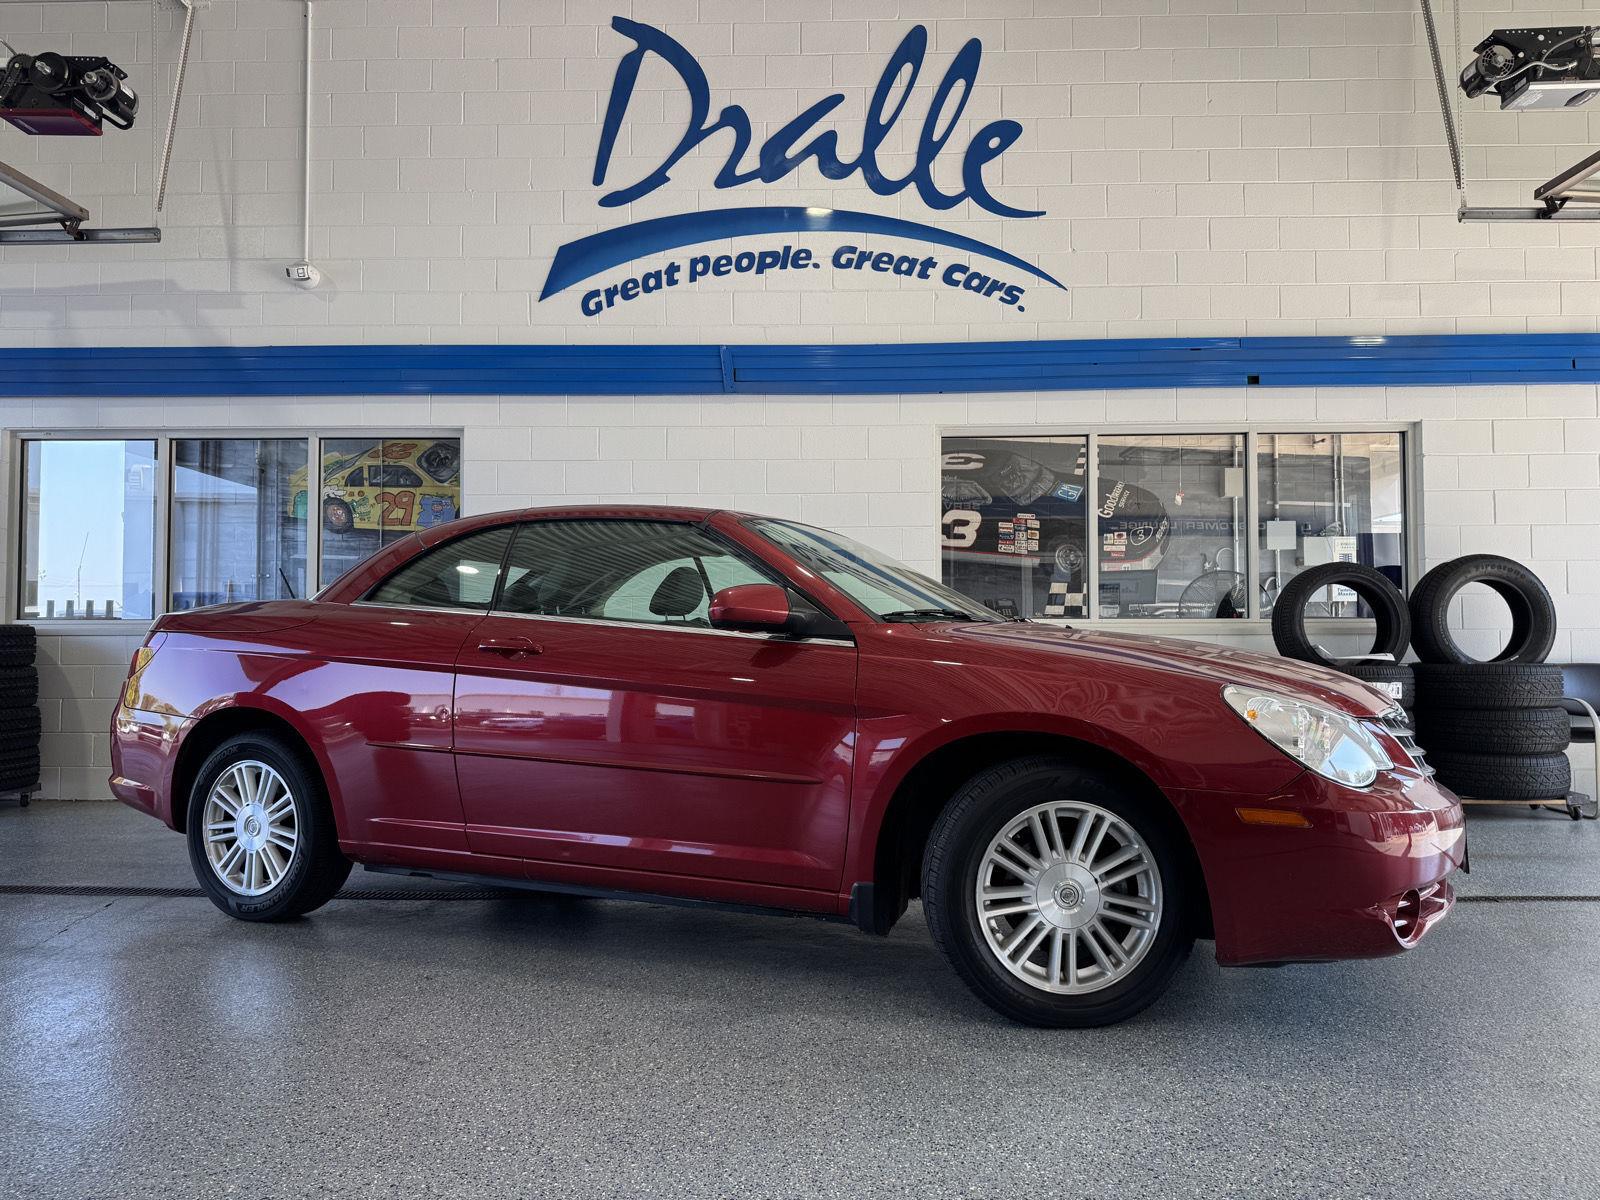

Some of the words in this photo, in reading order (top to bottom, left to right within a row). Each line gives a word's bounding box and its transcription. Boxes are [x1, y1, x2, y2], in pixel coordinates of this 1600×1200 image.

[592, 15, 1047, 218] Dralle
[581, 263, 681, 317] Great
[688, 245, 821, 284] people.
[831, 245, 937, 281] Great
[942, 263, 1026, 313] Cars.
[374, 490, 416, 527] 29
[941, 509, 982, 548] 3
[1137, 529, 1145, 541] 3
